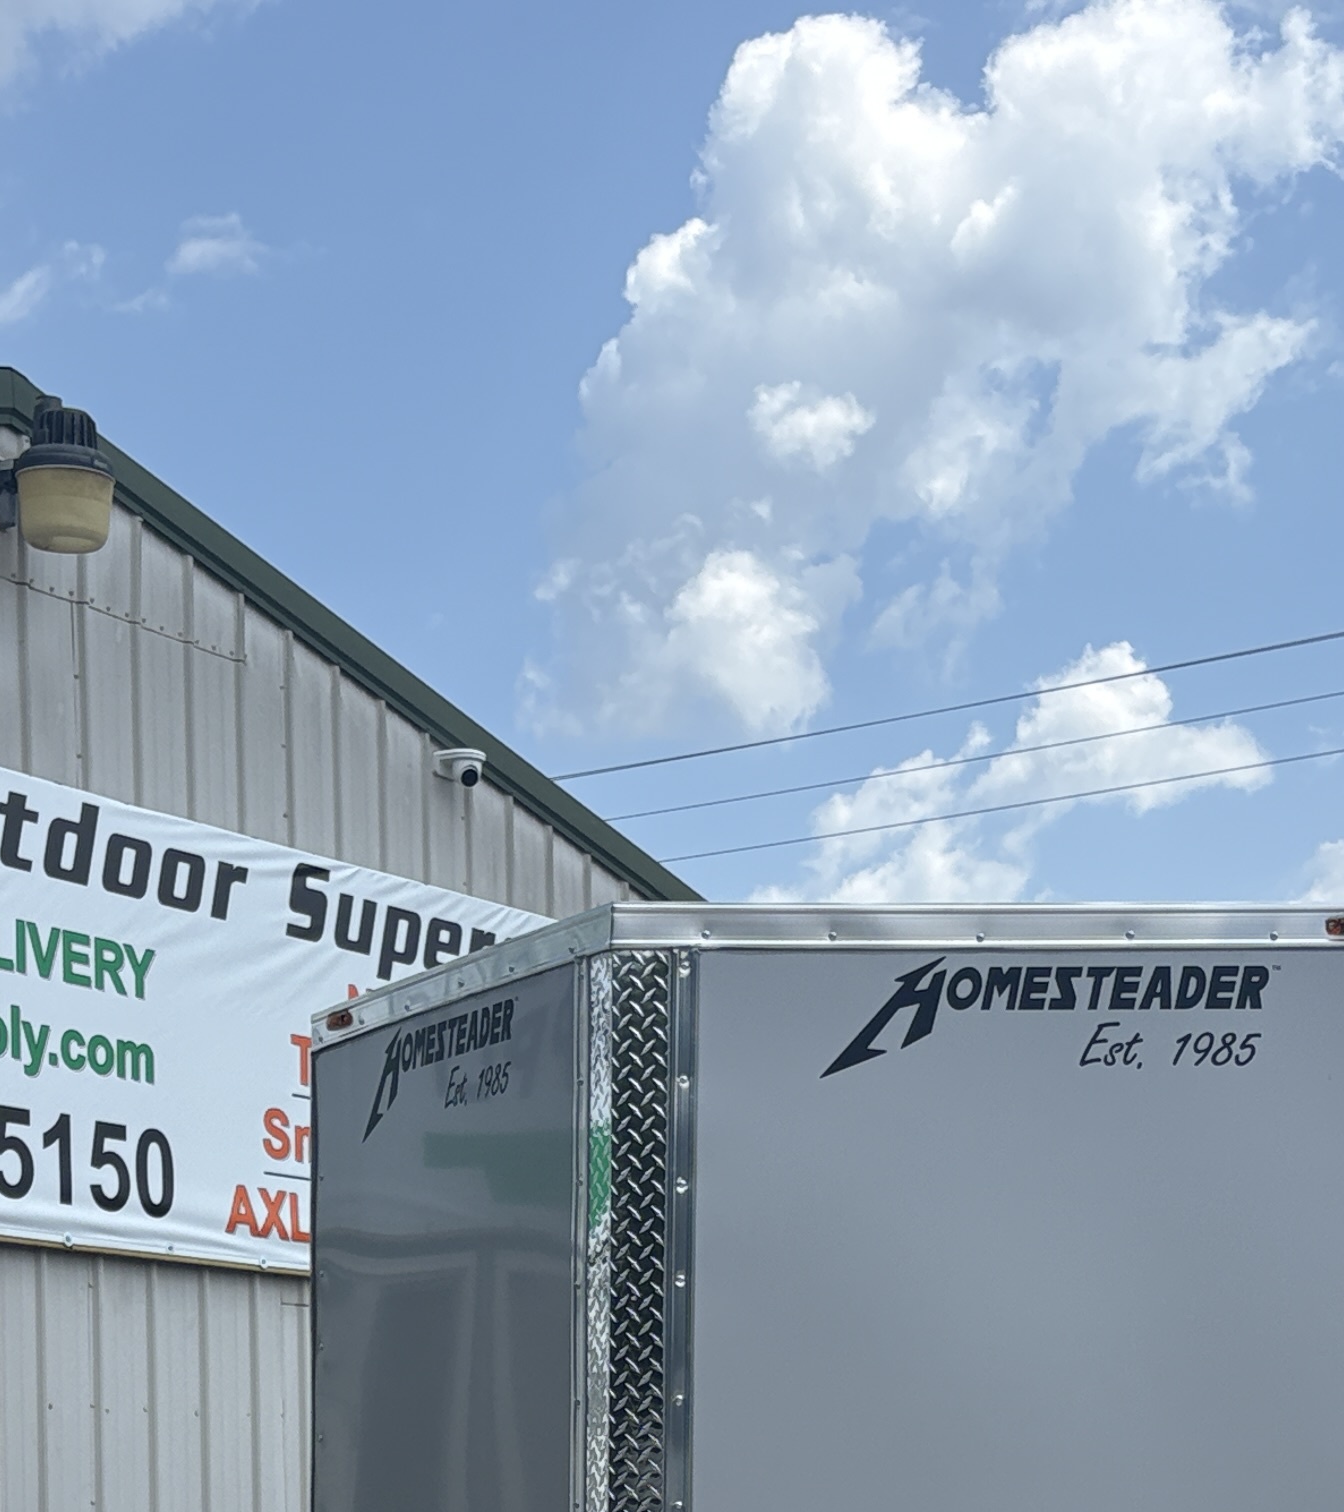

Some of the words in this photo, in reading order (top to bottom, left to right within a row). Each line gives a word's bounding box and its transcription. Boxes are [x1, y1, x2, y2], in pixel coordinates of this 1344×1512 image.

[819, 955, 1270, 1079] HOMESTEADER
[1079, 1022, 1144, 1069] Est.
[1172, 1031, 1262, 1067] 1985
[362, 998, 515, 1144] HOMESTEADER
[476, 1061, 512, 1100] 1985
